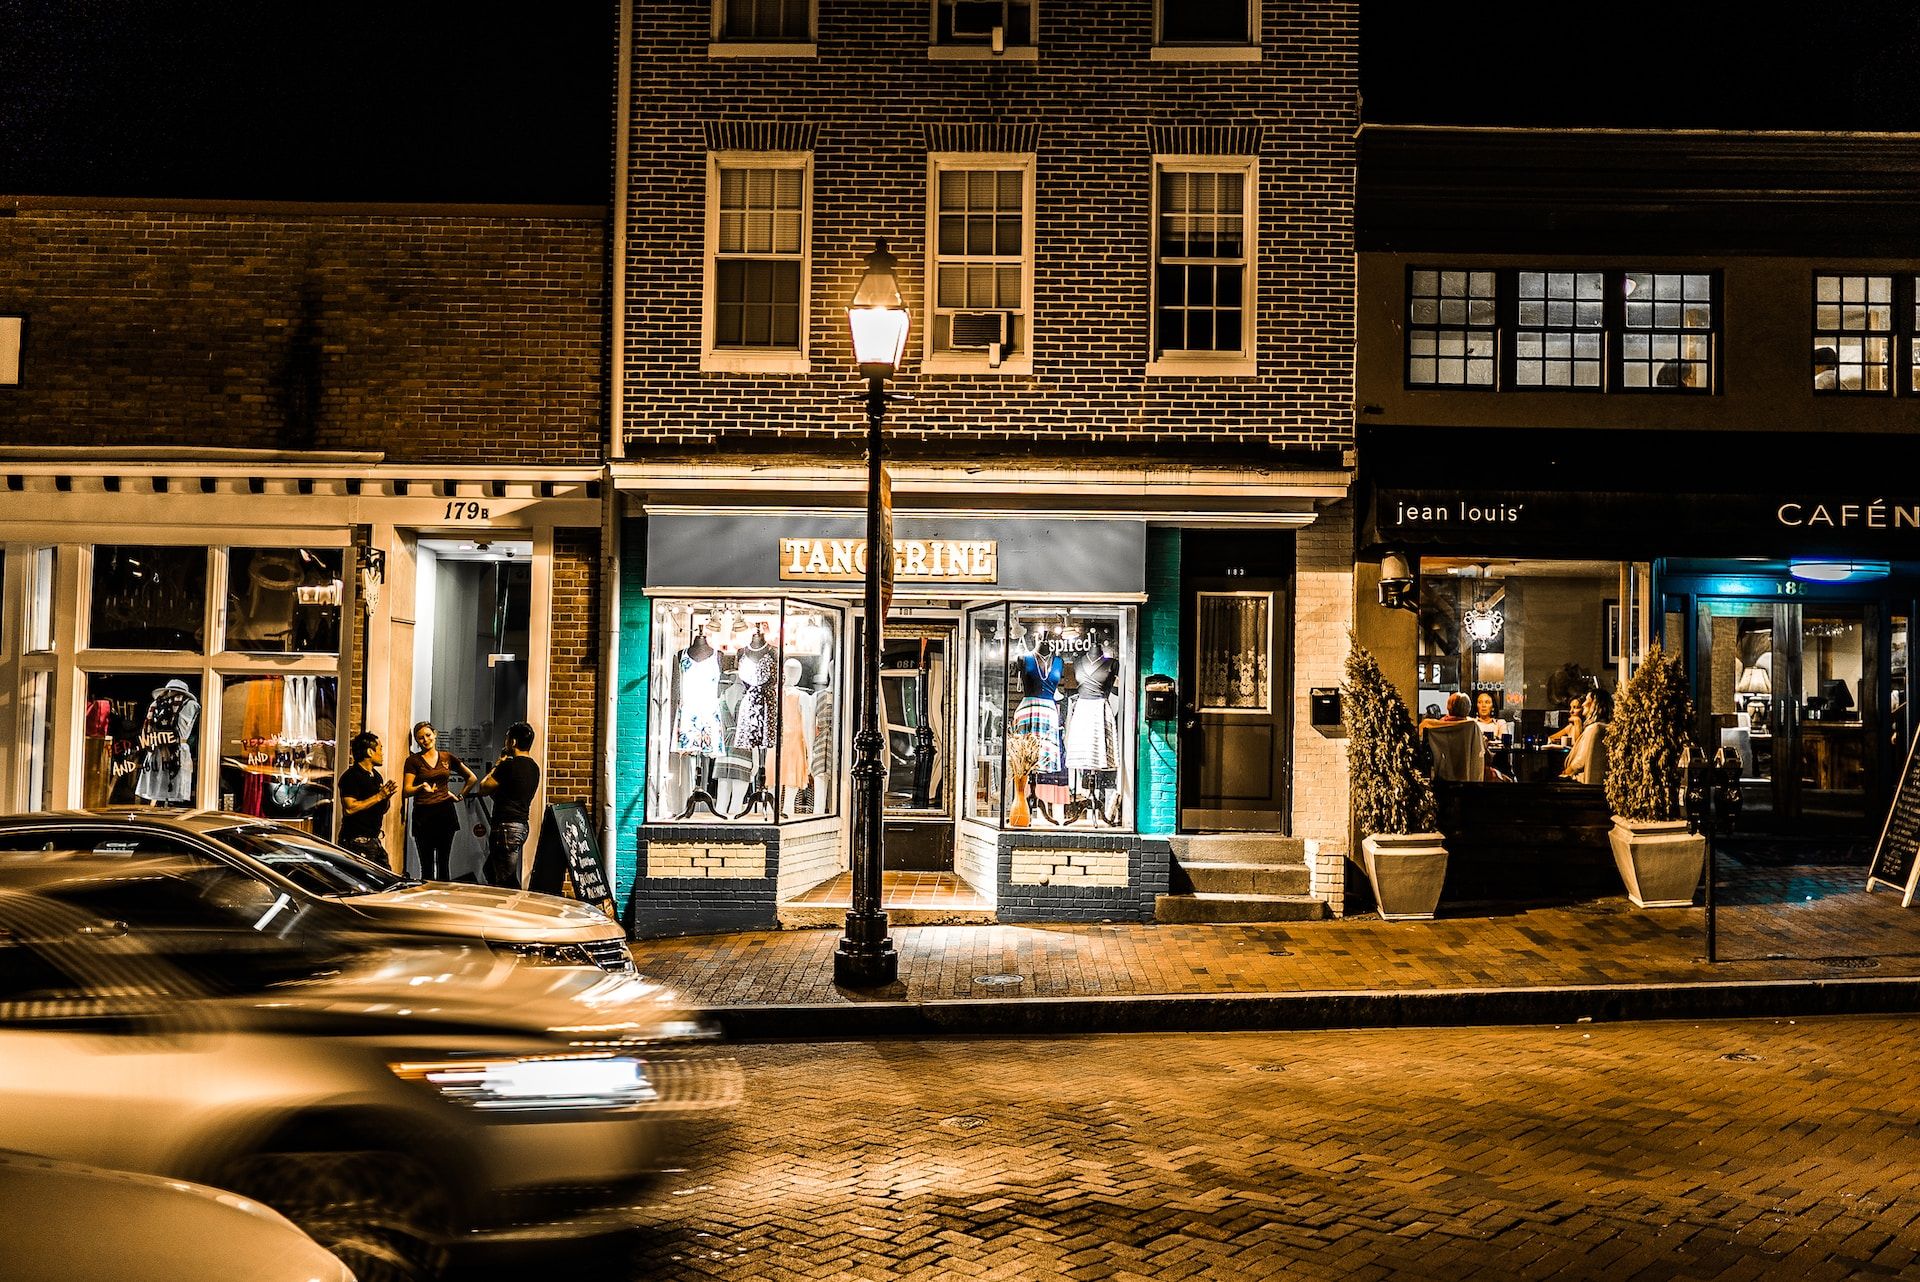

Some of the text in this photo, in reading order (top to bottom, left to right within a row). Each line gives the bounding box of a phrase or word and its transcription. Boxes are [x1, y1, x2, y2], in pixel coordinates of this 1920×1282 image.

[1396, 501, 1448, 525] jean
[248, 751, 269, 765] AND
[112, 759, 137, 777] AND
